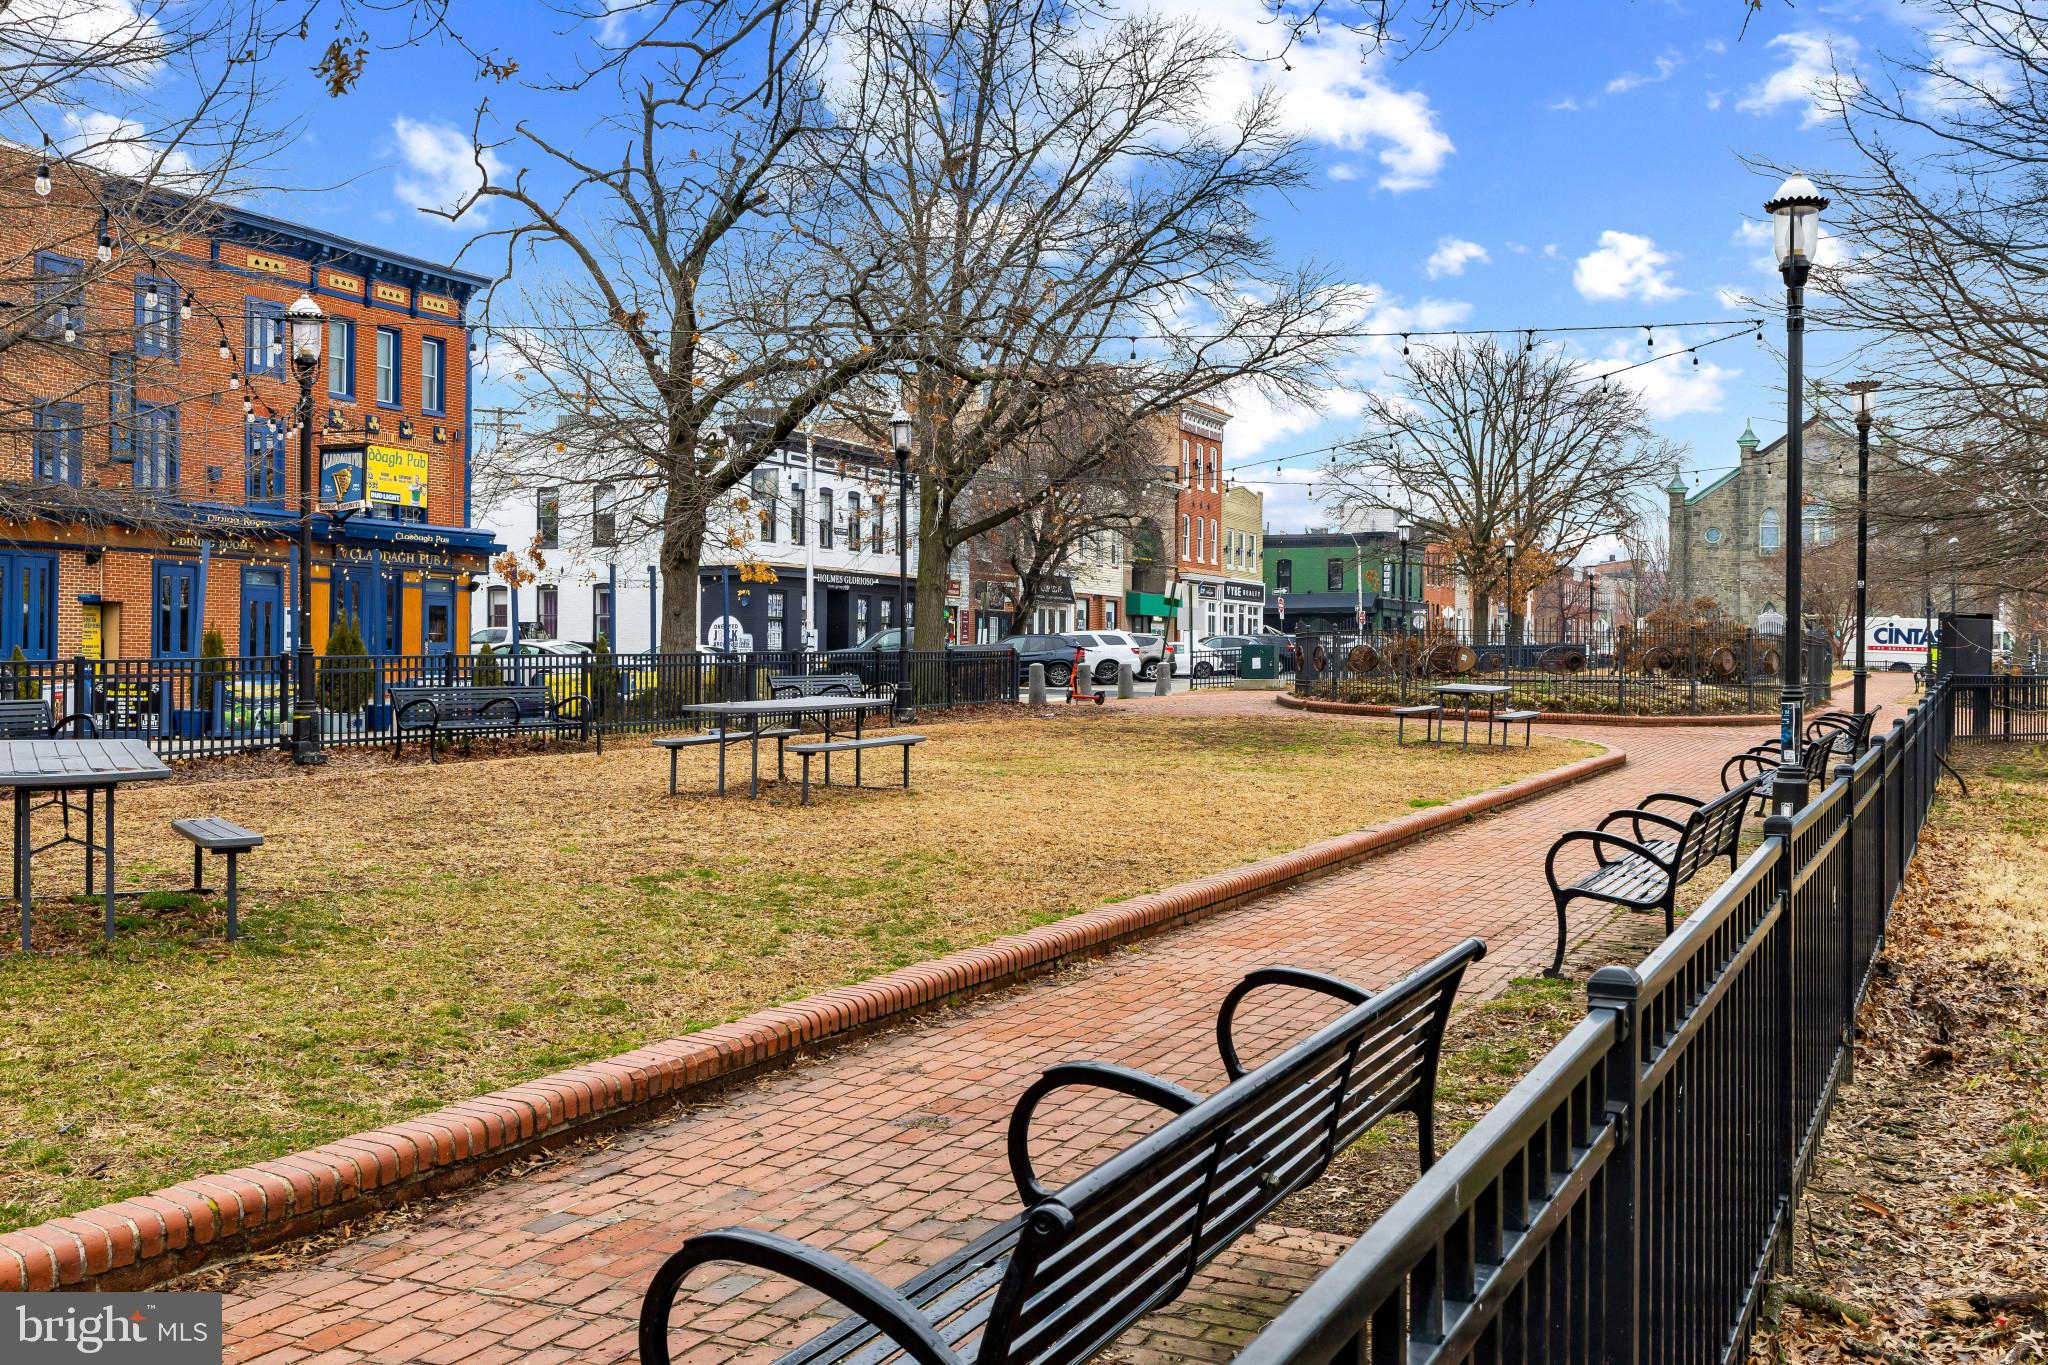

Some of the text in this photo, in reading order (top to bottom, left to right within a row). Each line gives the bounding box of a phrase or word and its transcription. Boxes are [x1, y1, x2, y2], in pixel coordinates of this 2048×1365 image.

[407, 451, 426, 469] Pub
[370, 491, 401, 502] BUD LIGHT
[207, 514, 271, 526] Dining Room
[395, 532, 433, 543] Claddagh
[219, 540, 248, 550] ROOM
[419, 553, 441, 565] PUB
[817, 573, 874, 586] HOLMES GLORIOSO
[1226, 585, 1242, 597] VYBE
[1243, 589, 1261, 598] REALTY
